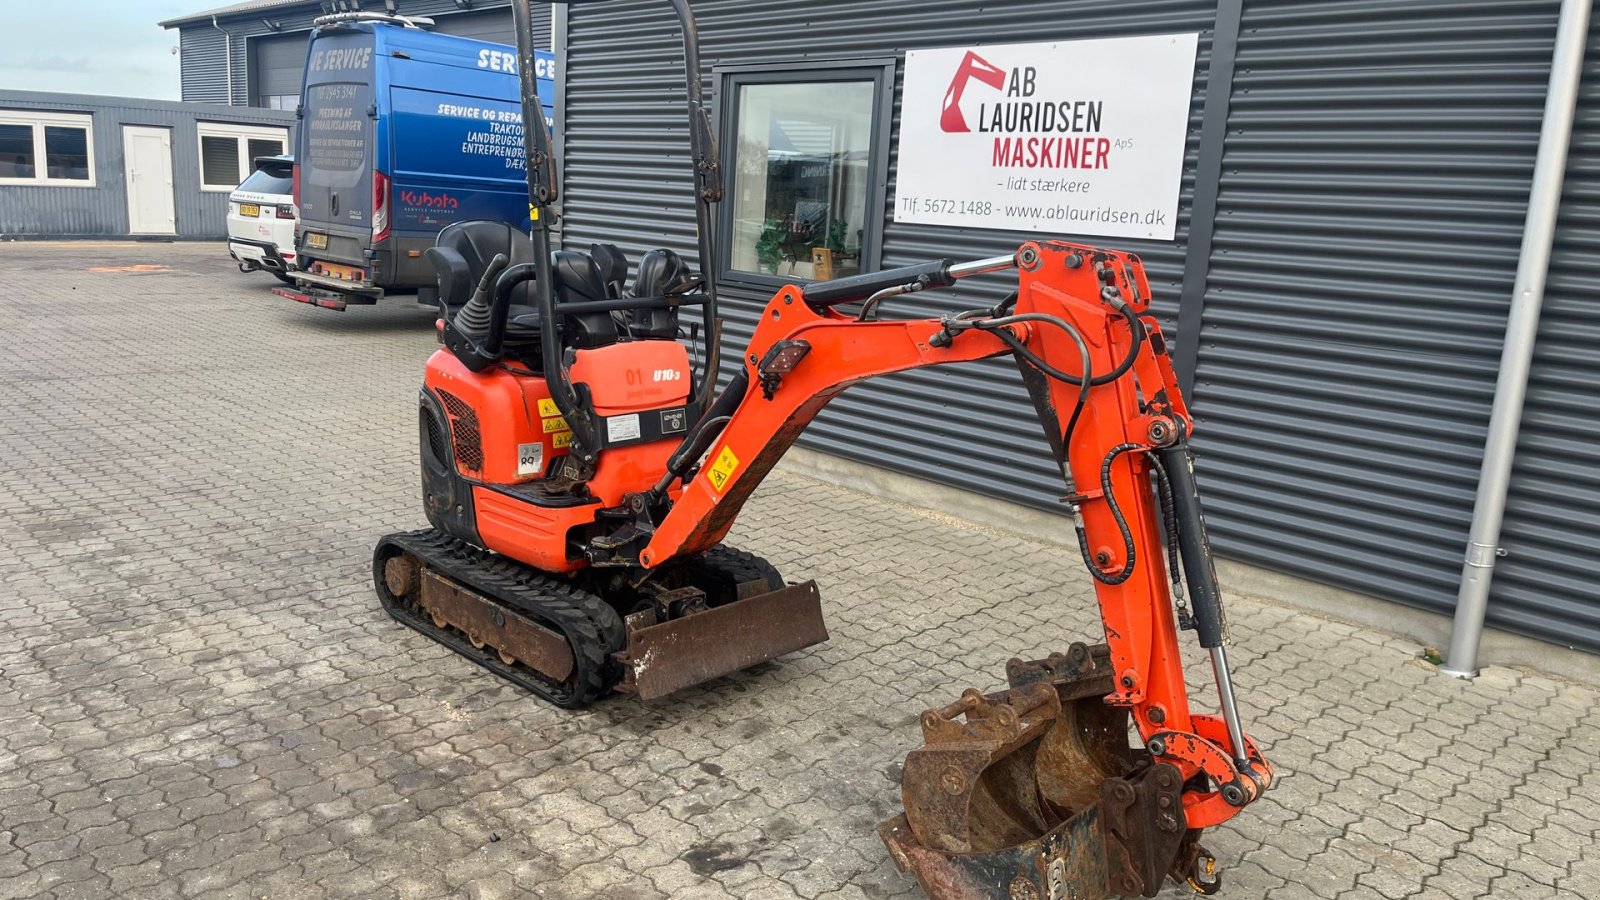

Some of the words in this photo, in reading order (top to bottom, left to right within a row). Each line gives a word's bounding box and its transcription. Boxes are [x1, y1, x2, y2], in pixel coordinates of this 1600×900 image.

[310, 51, 323, 71] JE
[323, 47, 372, 71] SERVICE
[477, 49, 556, 78] SERCE
[1007, 66, 1036, 97] AB
[343, 107, 353, 118] AF
[437, 103, 480, 119] SERVICE
[482, 109, 496, 119] OG
[978, 101, 1103, 133] LAURIDSEN
[489, 122, 525, 135] TRAKTO
[467, 131, 525, 147] LANDBRUGSM
[992, 136, 1111, 169] MASKINER
[1114, 138, 1133, 150] ApS
[1006, 176, 1028, 191] lidt
[1030, 177, 1090, 193] stærkere
[400, 190, 458, 209] Kubota
[902, 198, 920, 214] Tlf.
[924, 199, 956, 214] 5672
[960, 200, 992, 216] 1488
[1004, 203, 1167, 226] www.ablauridsen.dk
[625, 367, 642, 386] 01
[653, 369, 681, 382] U10-3
